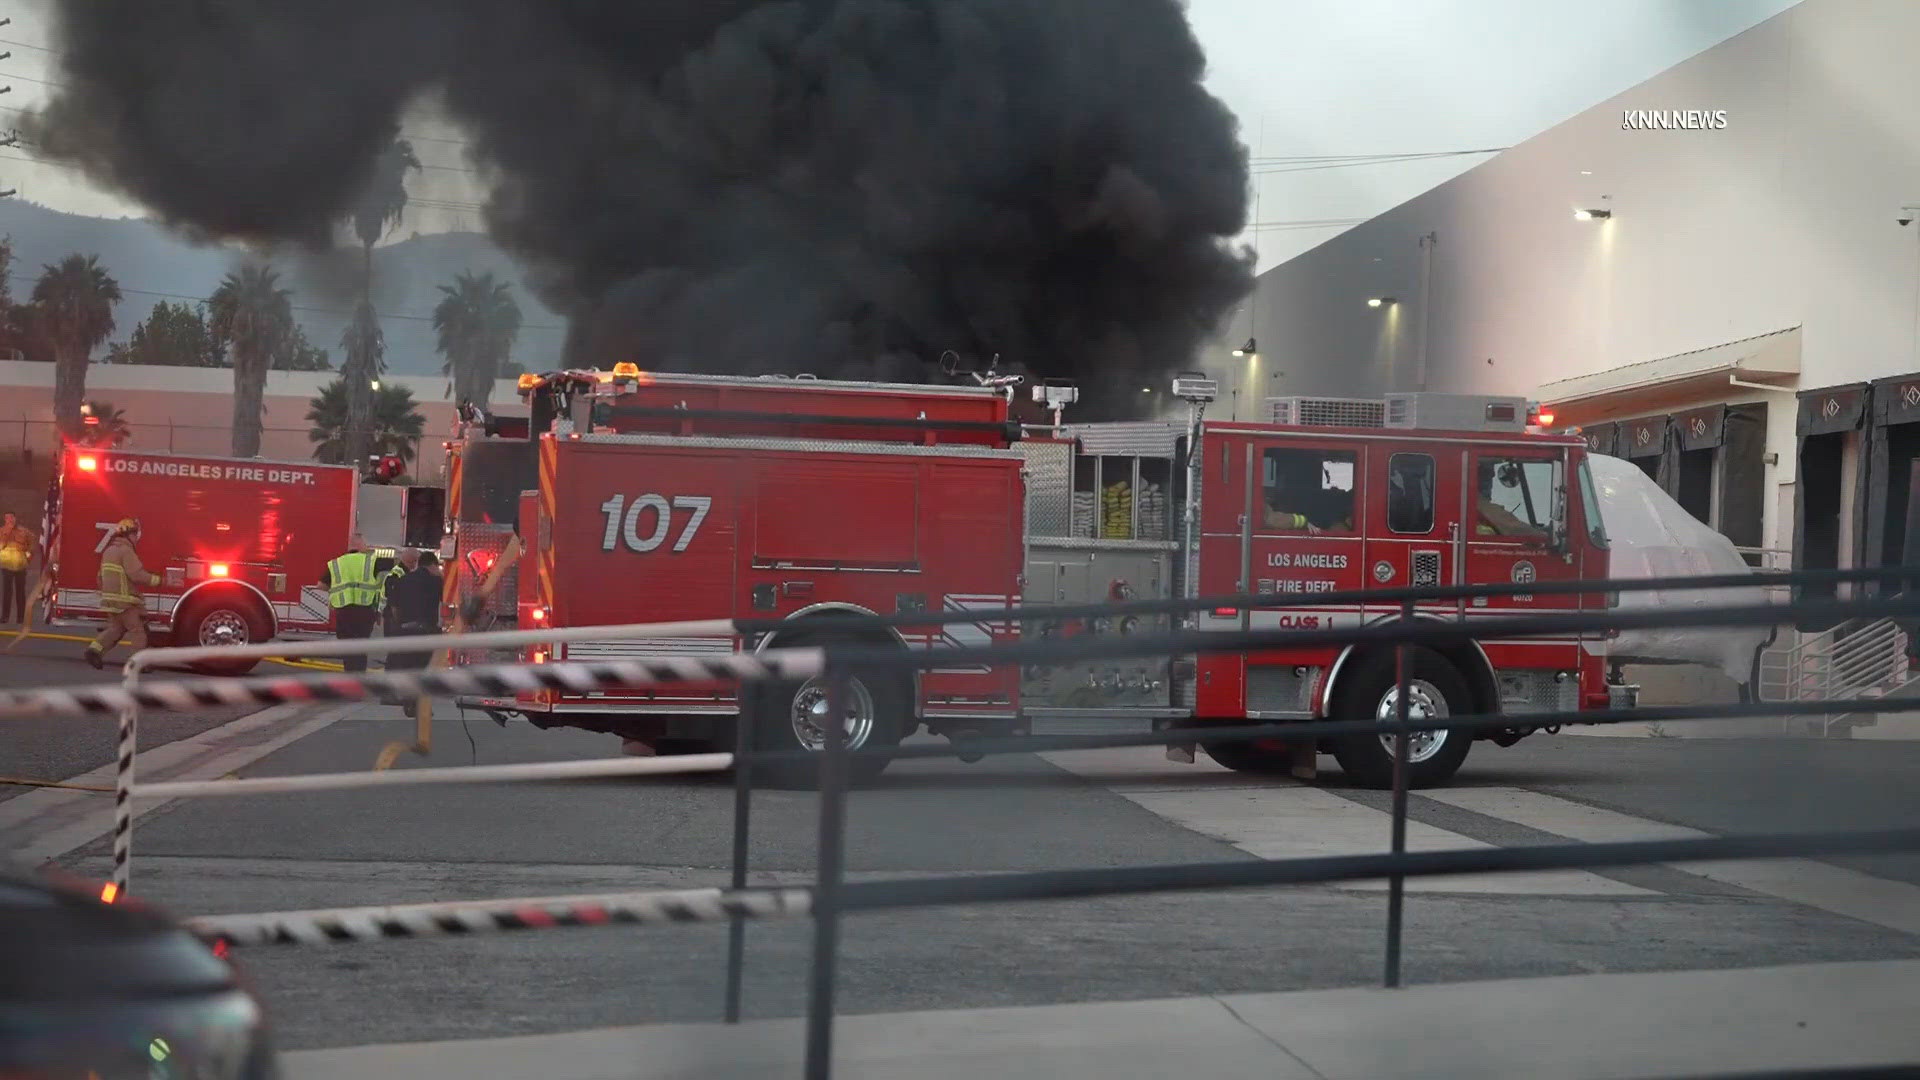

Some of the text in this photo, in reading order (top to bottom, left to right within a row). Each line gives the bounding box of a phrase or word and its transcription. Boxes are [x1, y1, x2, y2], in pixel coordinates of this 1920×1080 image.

[104, 459, 316, 486] LOS ANGELES FIRE DEPT.
[602, 493, 712, 552] 107
[1267, 553, 1348, 569] LOS ANGELES
[1276, 579, 1302, 593] FIRE
[1279, 615, 1333, 629] CLASS 1
